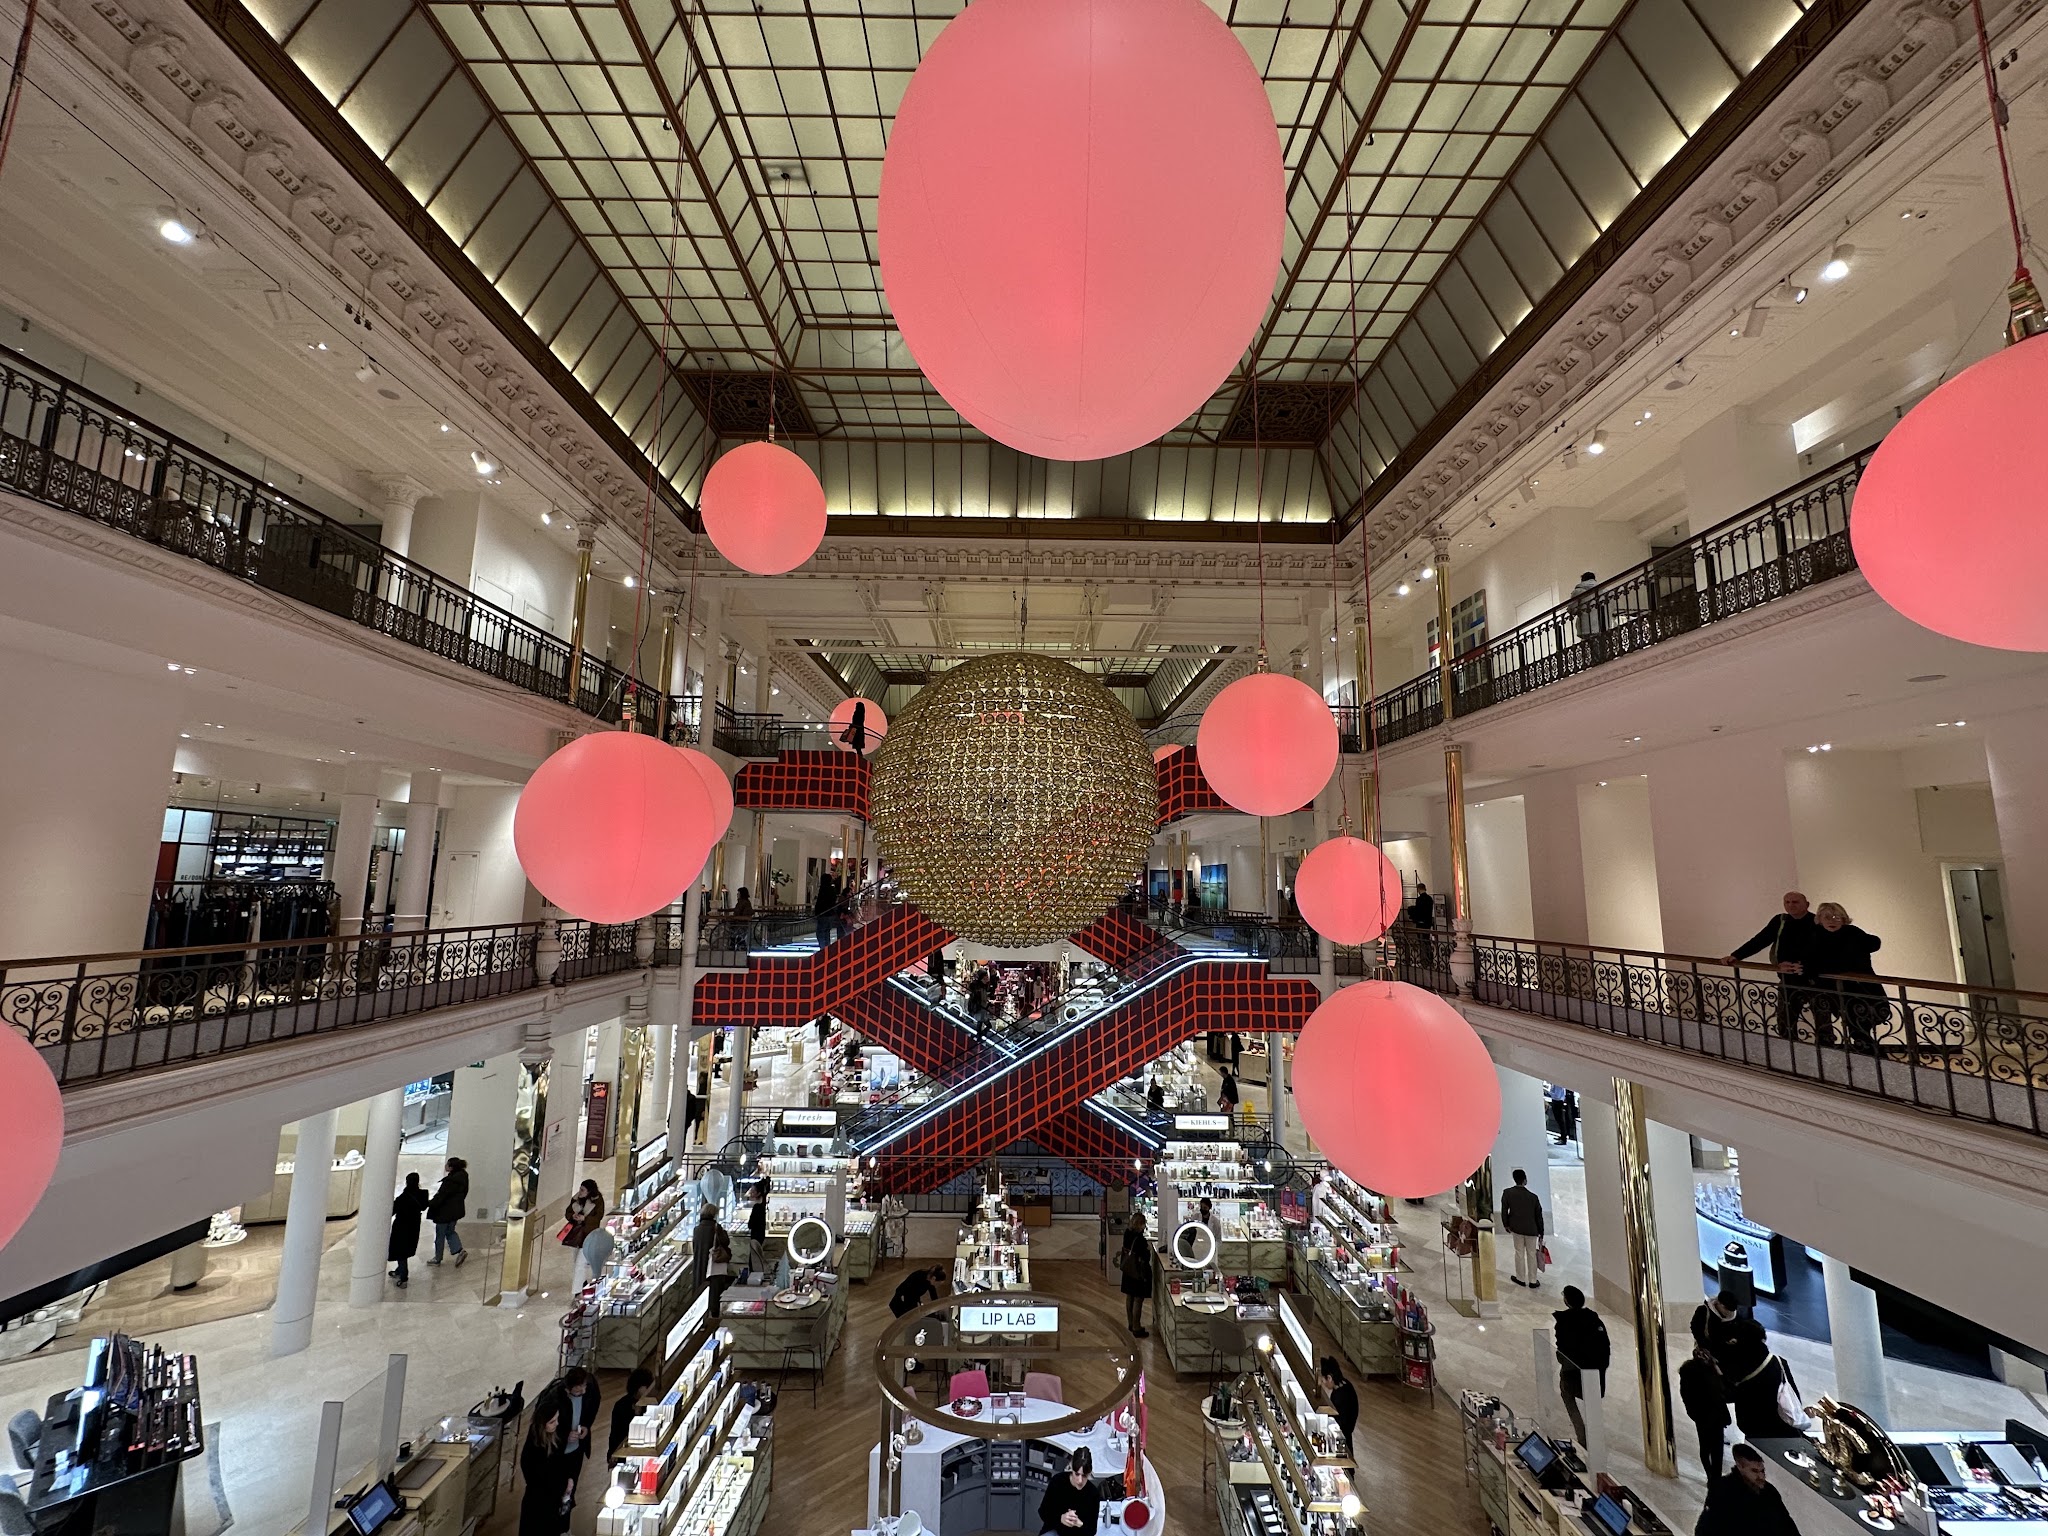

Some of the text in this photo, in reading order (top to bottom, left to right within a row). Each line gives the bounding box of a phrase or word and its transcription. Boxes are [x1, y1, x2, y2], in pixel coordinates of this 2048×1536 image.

[797, 1113, 823, 1122] fresh
[1731, 1234, 1763, 1249] SENSAI
[982, 1312, 1036, 1326] LIP LAB
